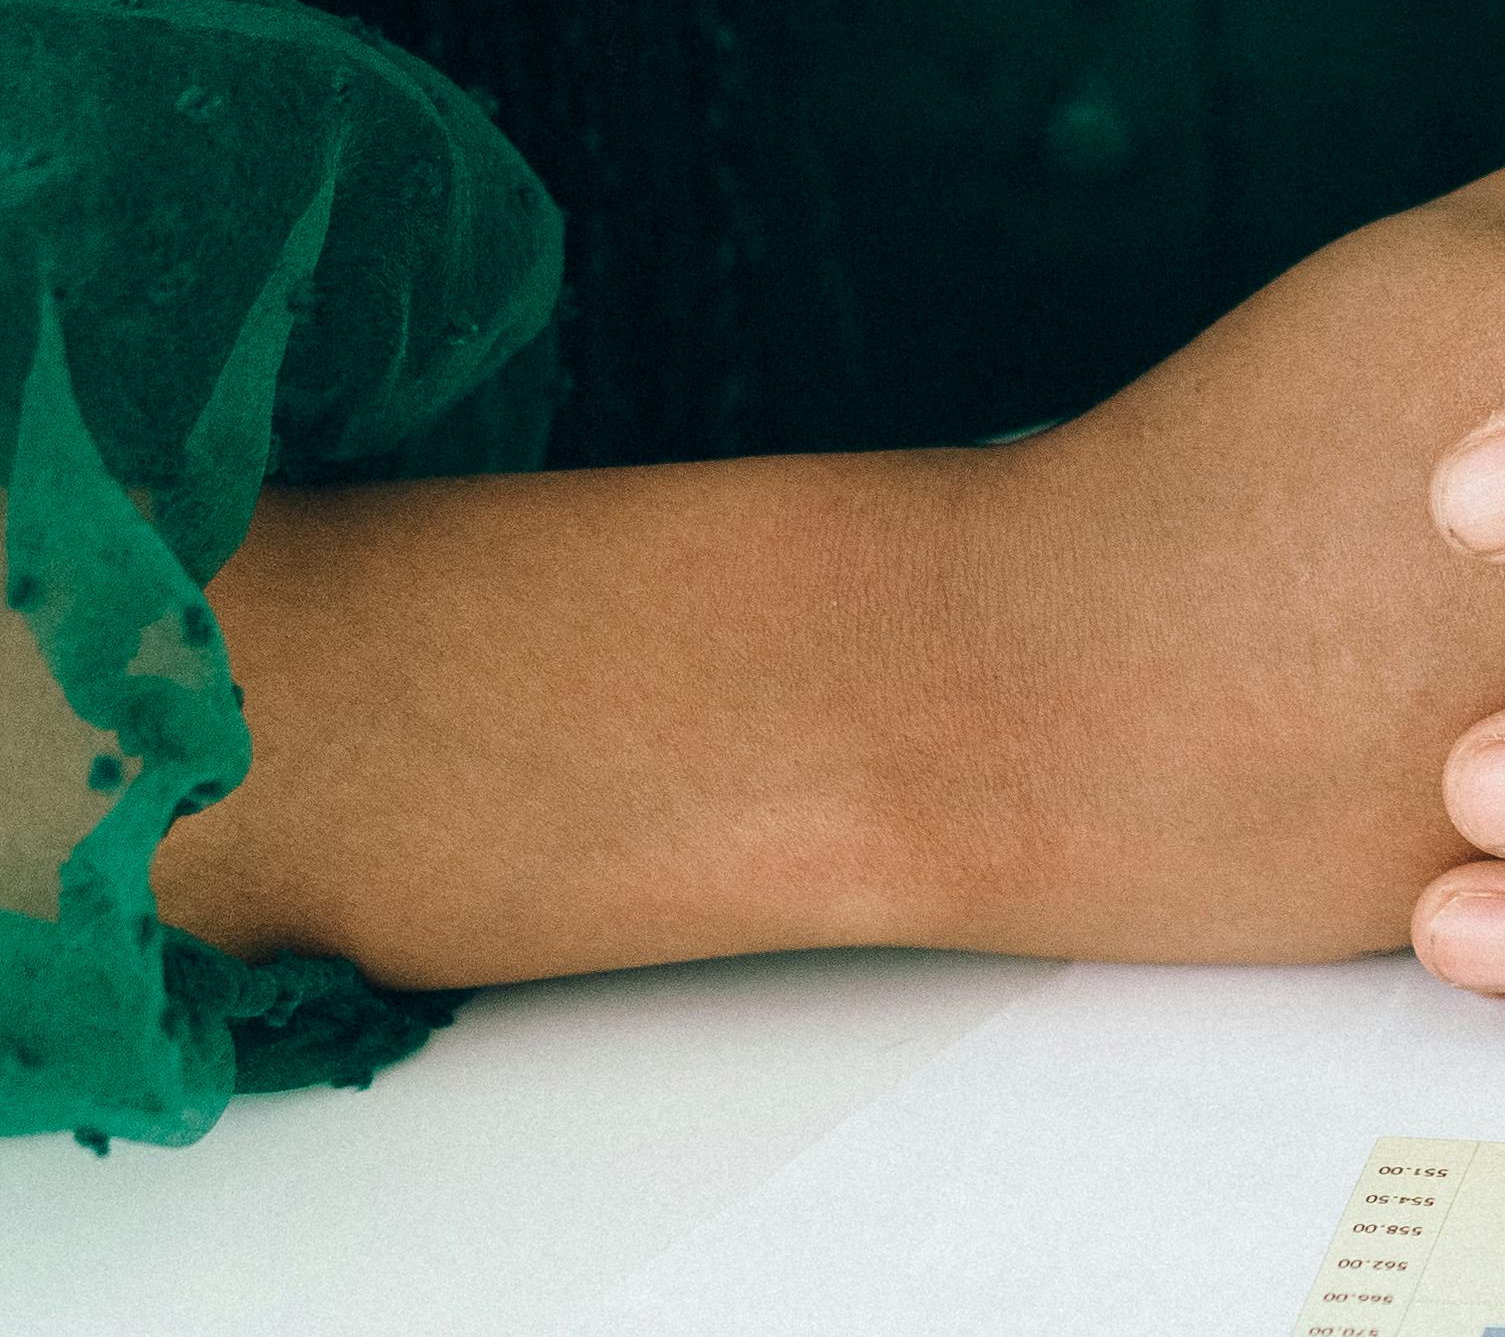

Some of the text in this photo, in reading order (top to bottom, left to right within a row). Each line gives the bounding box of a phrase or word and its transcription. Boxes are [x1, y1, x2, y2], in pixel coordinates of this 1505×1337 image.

[1378, 1166, 1448, 1178] 551.00
[1365, 1195, 1436, 1207] 554.50
[1352, 1223, 1423, 1237] 558.00
[1337, 1258, 1408, 1272] 562.00
[1323, 1292, 1394, 1305] 566.00
[1308, 1326, 1379, 1337] 570.00
